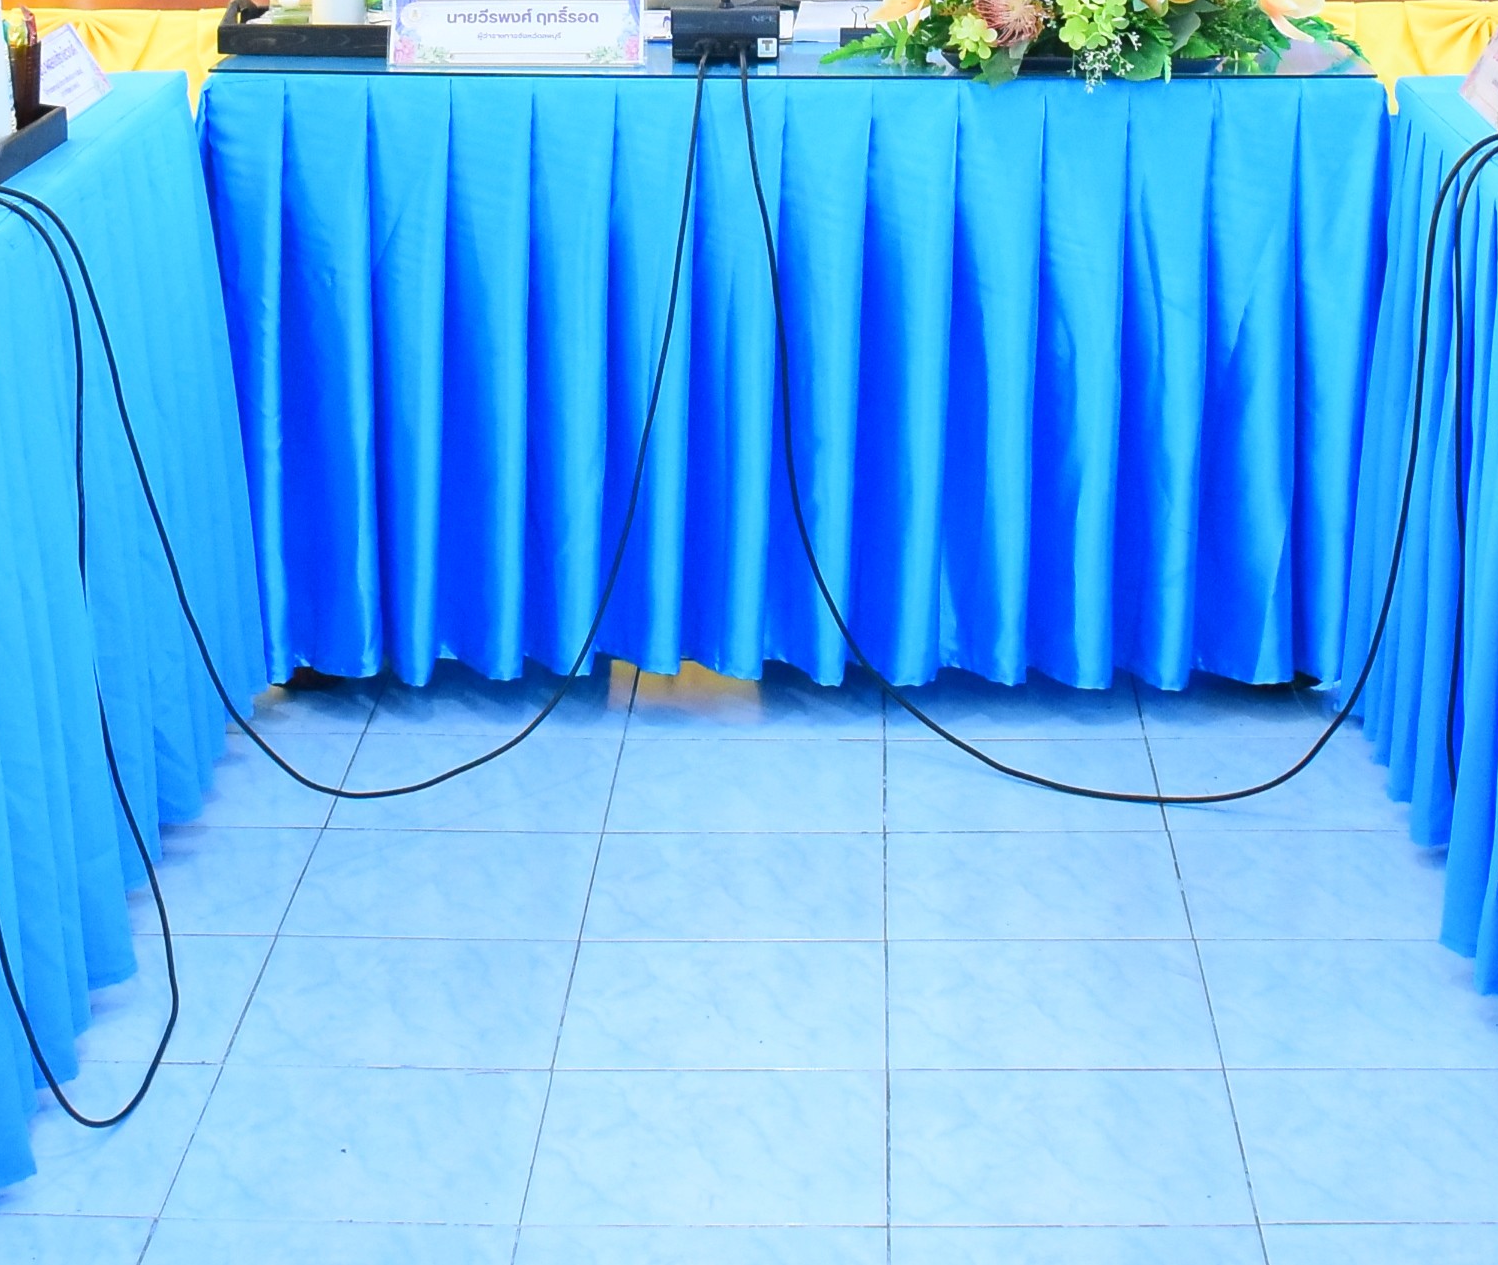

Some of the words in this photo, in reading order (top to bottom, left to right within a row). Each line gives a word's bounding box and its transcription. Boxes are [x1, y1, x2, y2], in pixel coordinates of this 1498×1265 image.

[446, 8, 533, 24] นายวีรพงศ์
[536, 5, 600, 27] ฤทธิ์รอด
